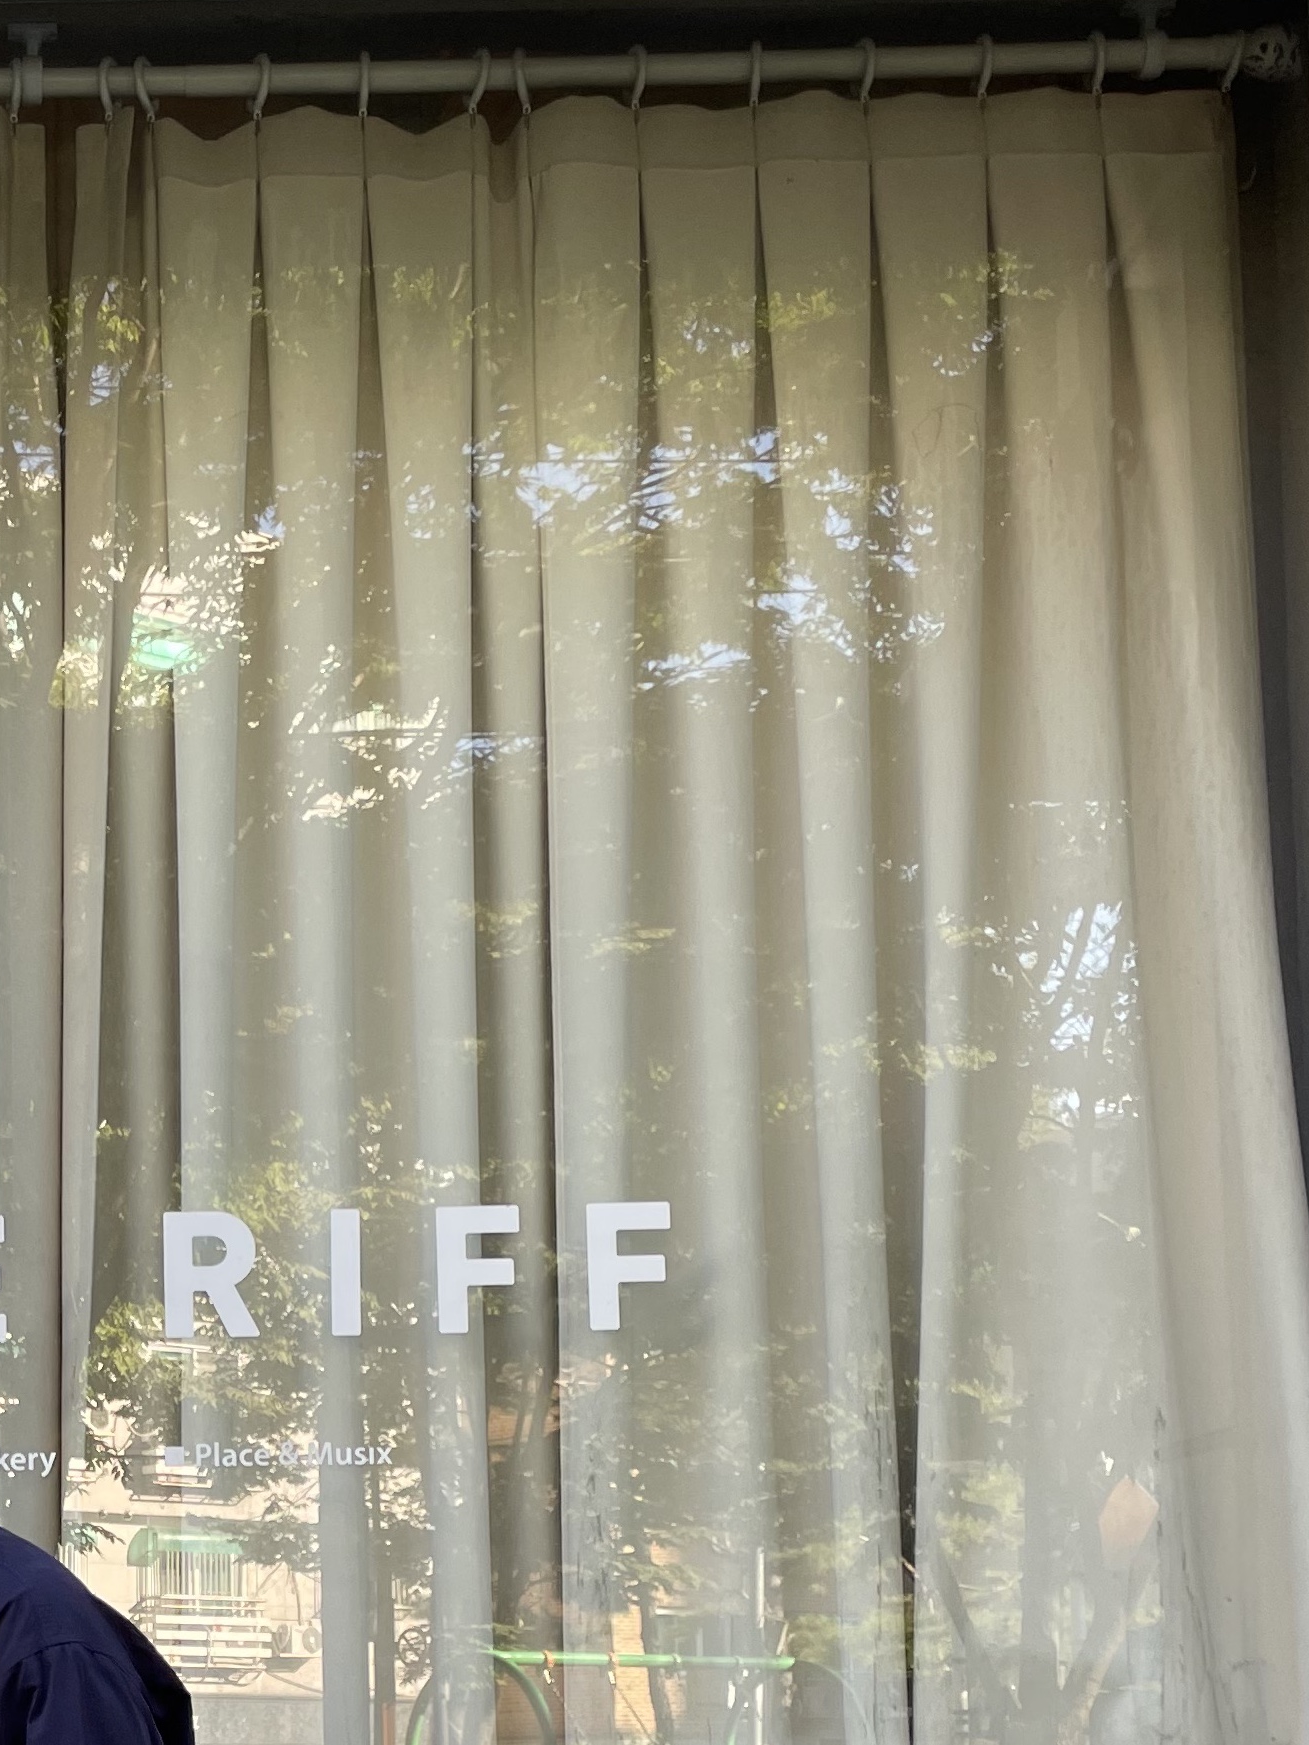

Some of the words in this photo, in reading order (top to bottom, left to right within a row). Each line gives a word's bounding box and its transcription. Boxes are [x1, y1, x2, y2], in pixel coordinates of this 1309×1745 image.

[161, 1200, 673, 1340] RIFF
[195, 1441, 271, 1468] Place
[277, 1440, 299, 1466] &
[307, 1441, 393, 1466] Musix
